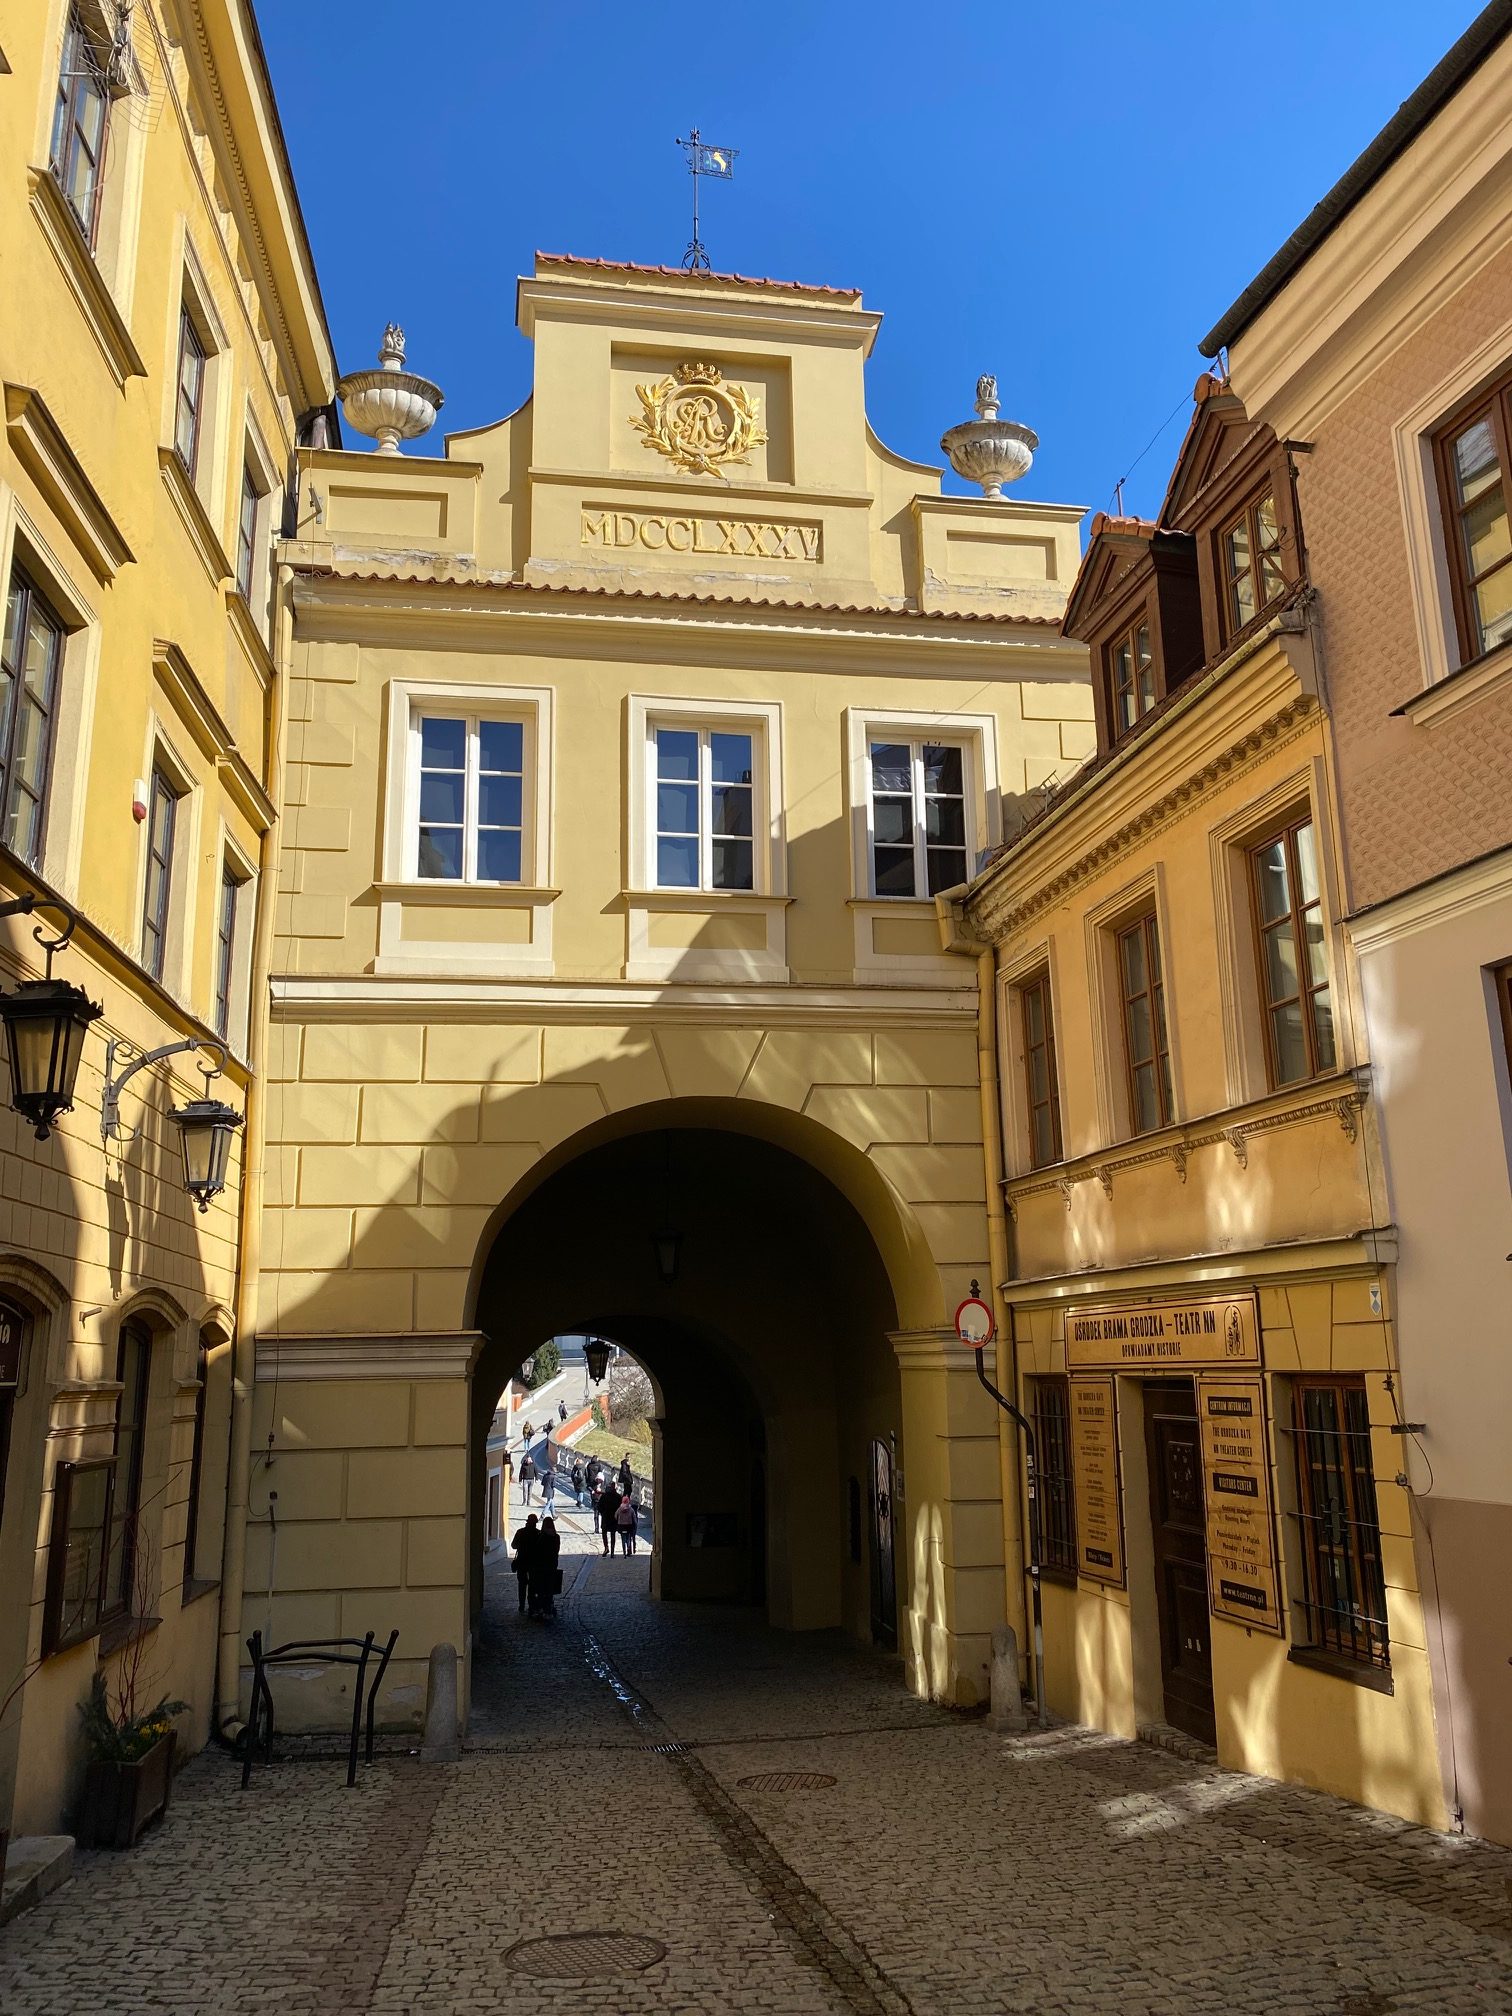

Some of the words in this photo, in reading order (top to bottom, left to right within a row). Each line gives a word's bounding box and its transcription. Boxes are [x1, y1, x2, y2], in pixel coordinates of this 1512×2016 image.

[580, 510, 821, 561] MDCCLXXXV
[1074, 1318, 1102, 1342] OŚRODEK
[1103, 1317, 1129, 1340] BRAMA
[1130, 1314, 1165, 1338] GRODZKA
[1173, 1311, 1201, 1335] TEATR
[1203, 1310, 1216, 1334] NN
[1212, 1426, 1220, 1437] THE
[1219, 1444, 1237, 1456] THEATER
